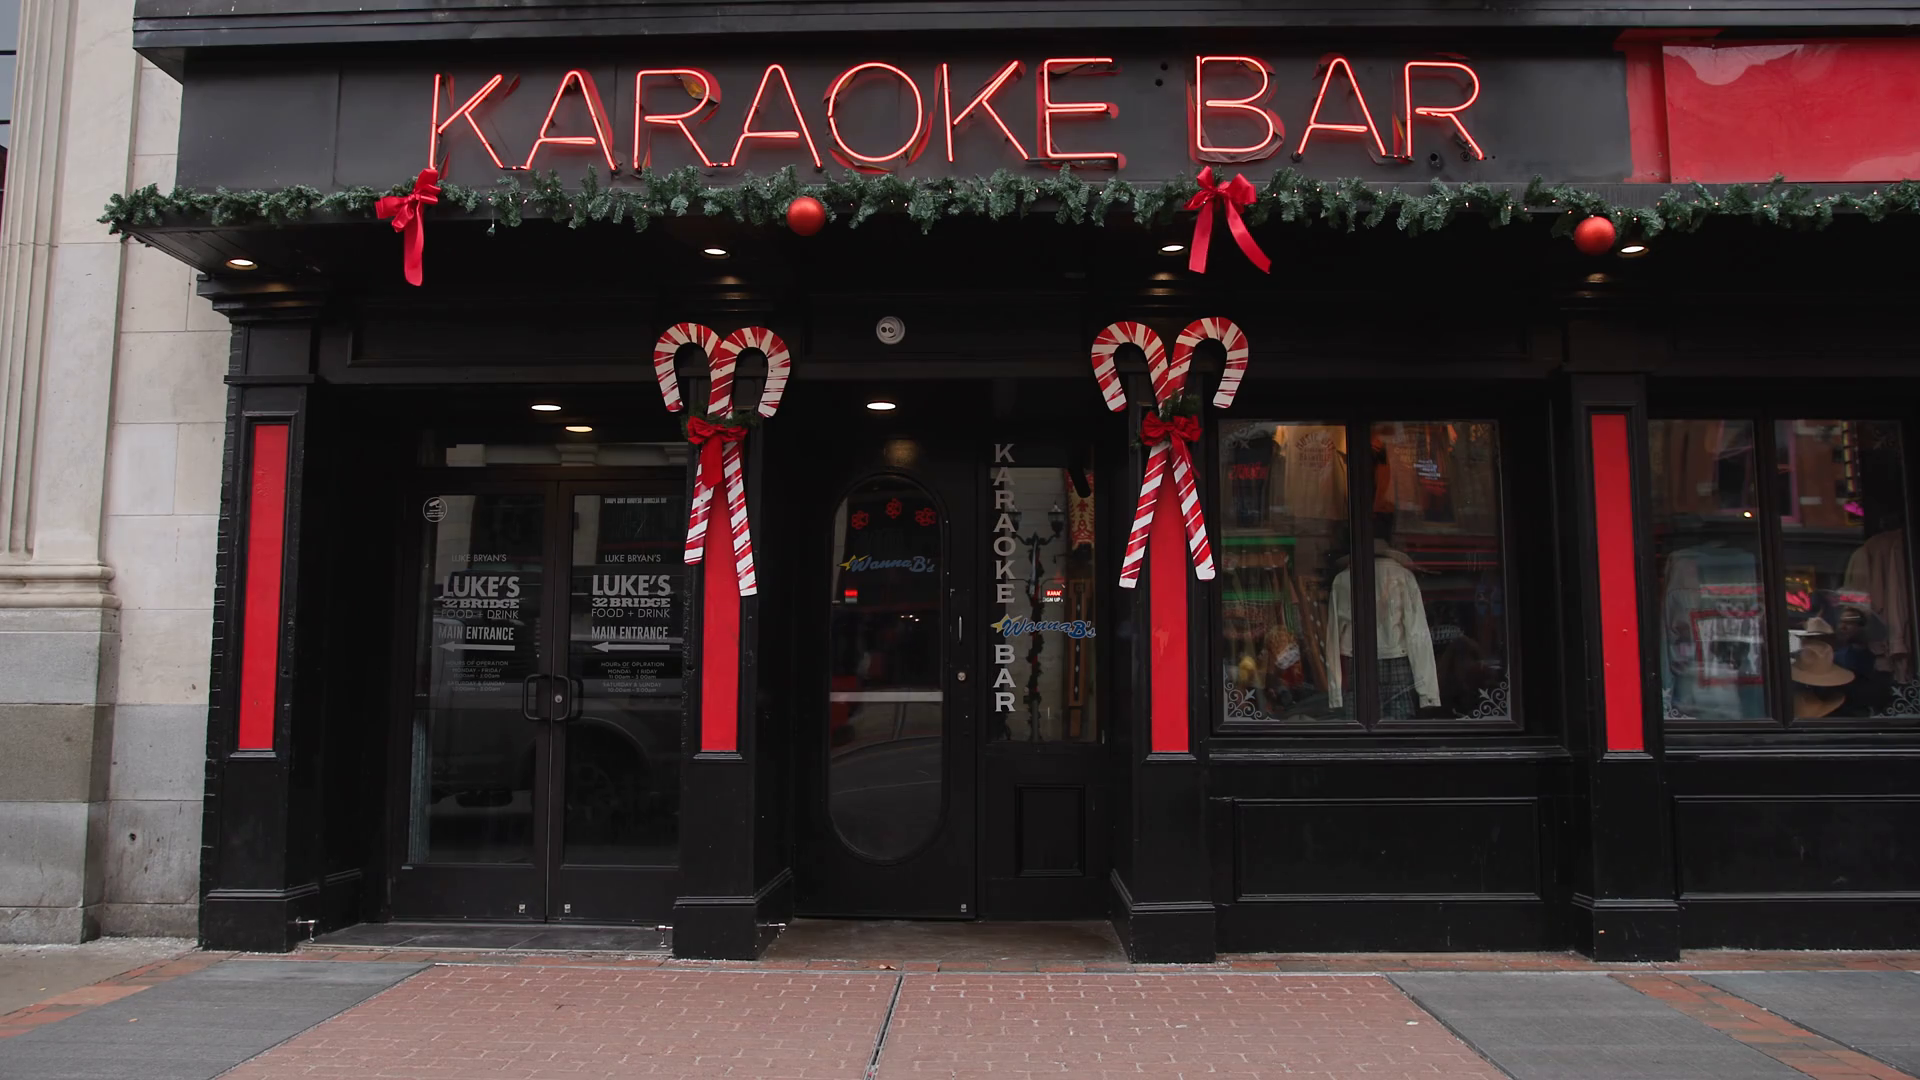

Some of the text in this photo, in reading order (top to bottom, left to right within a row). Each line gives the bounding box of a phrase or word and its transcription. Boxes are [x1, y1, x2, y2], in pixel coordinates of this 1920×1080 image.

[428, 55, 1484, 171] KARAOKE BAR
[451, 553, 507, 562] LUKE BRYAN'S
[604, 554, 662, 563] LUKE BRYAN'S
[993, 443, 1017, 712] KARAOKE BAR
[442, 576, 521, 598] LUKE'S
[592, 574, 671, 597] LUKE'S
[441, 598, 520, 609] 32 BRIDGE
[592, 597, 671, 608] 32 BRIDGE
[441, 609, 473, 619] FOOD
[487, 609, 519, 619] DRINK
[591, 608, 624, 618] FOOD
[637, 608, 671, 618] DRINK
[438, 626, 515, 641] MAIN ENTRANCE
[591, 626, 668, 640] MAIN ENTRANCE
